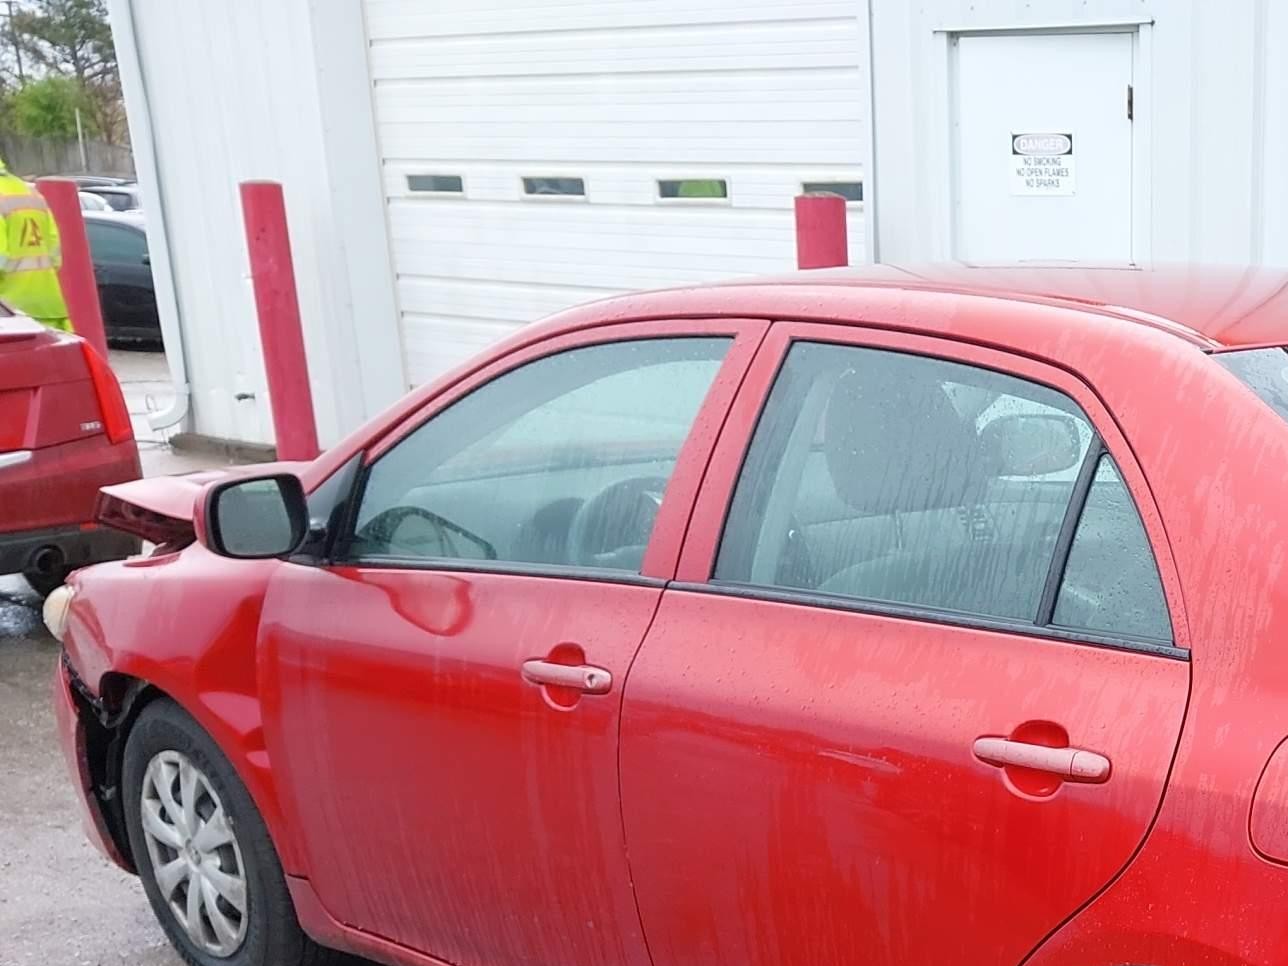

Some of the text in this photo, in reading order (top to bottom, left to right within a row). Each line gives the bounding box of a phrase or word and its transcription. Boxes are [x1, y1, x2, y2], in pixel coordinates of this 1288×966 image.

[1019, 139, 1064, 151] DANGER
[1023, 157, 1062, 166] NO SMOKING
[1016, 168, 1069, 177] NO OPEN FLAMES
[1025, 178, 1060, 188] NO SPARKS
